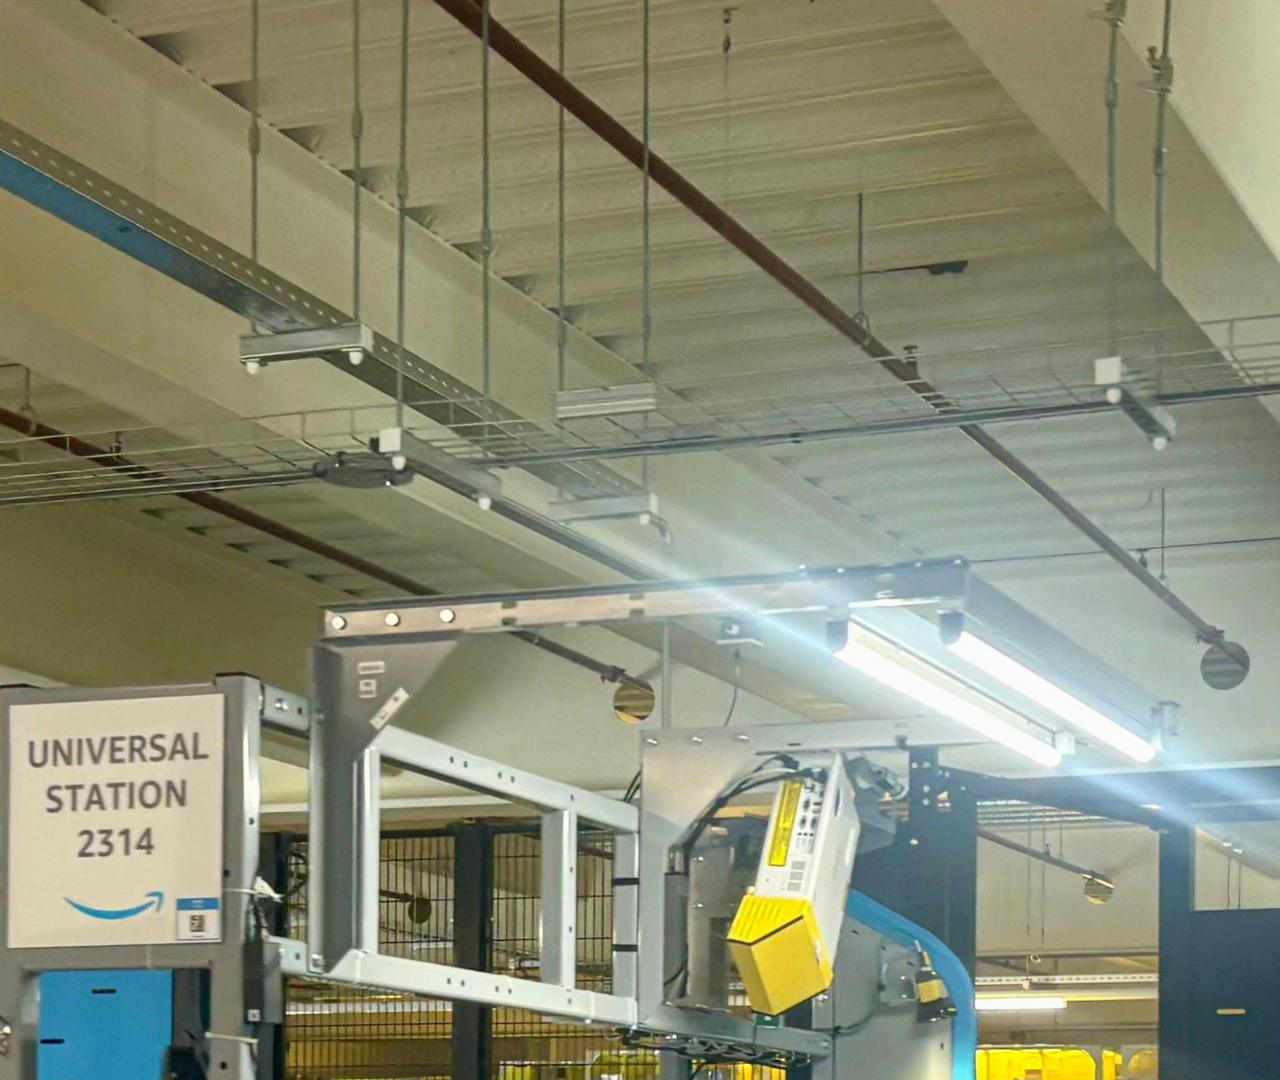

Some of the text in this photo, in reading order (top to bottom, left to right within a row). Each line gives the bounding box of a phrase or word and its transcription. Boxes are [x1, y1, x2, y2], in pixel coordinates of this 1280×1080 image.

[27, 732, 210, 769] UNIVERSAL
[46, 779, 188, 814] STATION
[77, 827, 155, 858] 2314
